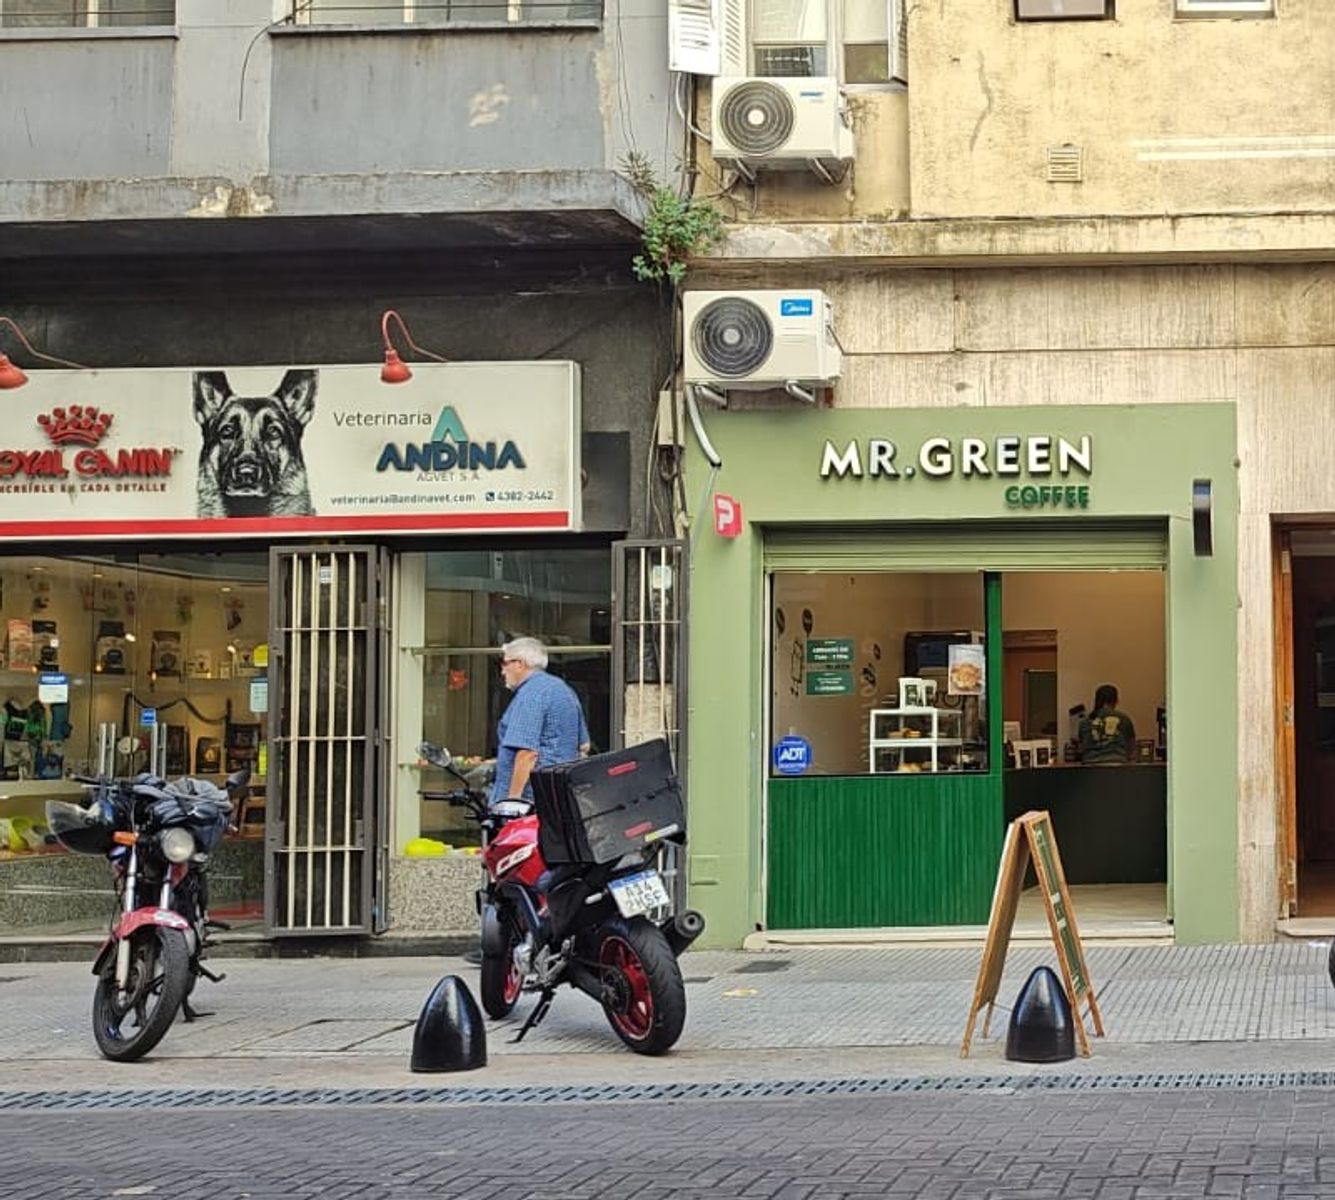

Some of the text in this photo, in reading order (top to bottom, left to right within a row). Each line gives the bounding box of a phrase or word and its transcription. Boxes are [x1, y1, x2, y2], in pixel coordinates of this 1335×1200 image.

[333, 411, 432, 426] Veterinaria
[0, 448, 172, 477] OYAL CANIN
[376, 440, 527, 472] ANDINA
[416, 472, 455, 482] AGVET
[0, 482, 54, 493] NCREÍBLE
[80, 484, 110, 492] CADA
[116, 483, 166, 492] DETALLE
[331, 492, 476, 505] veterinaria@andinavet.com
[1005, 485, 1089, 507] COFFEE
[780, 747, 806, 761] ADT
